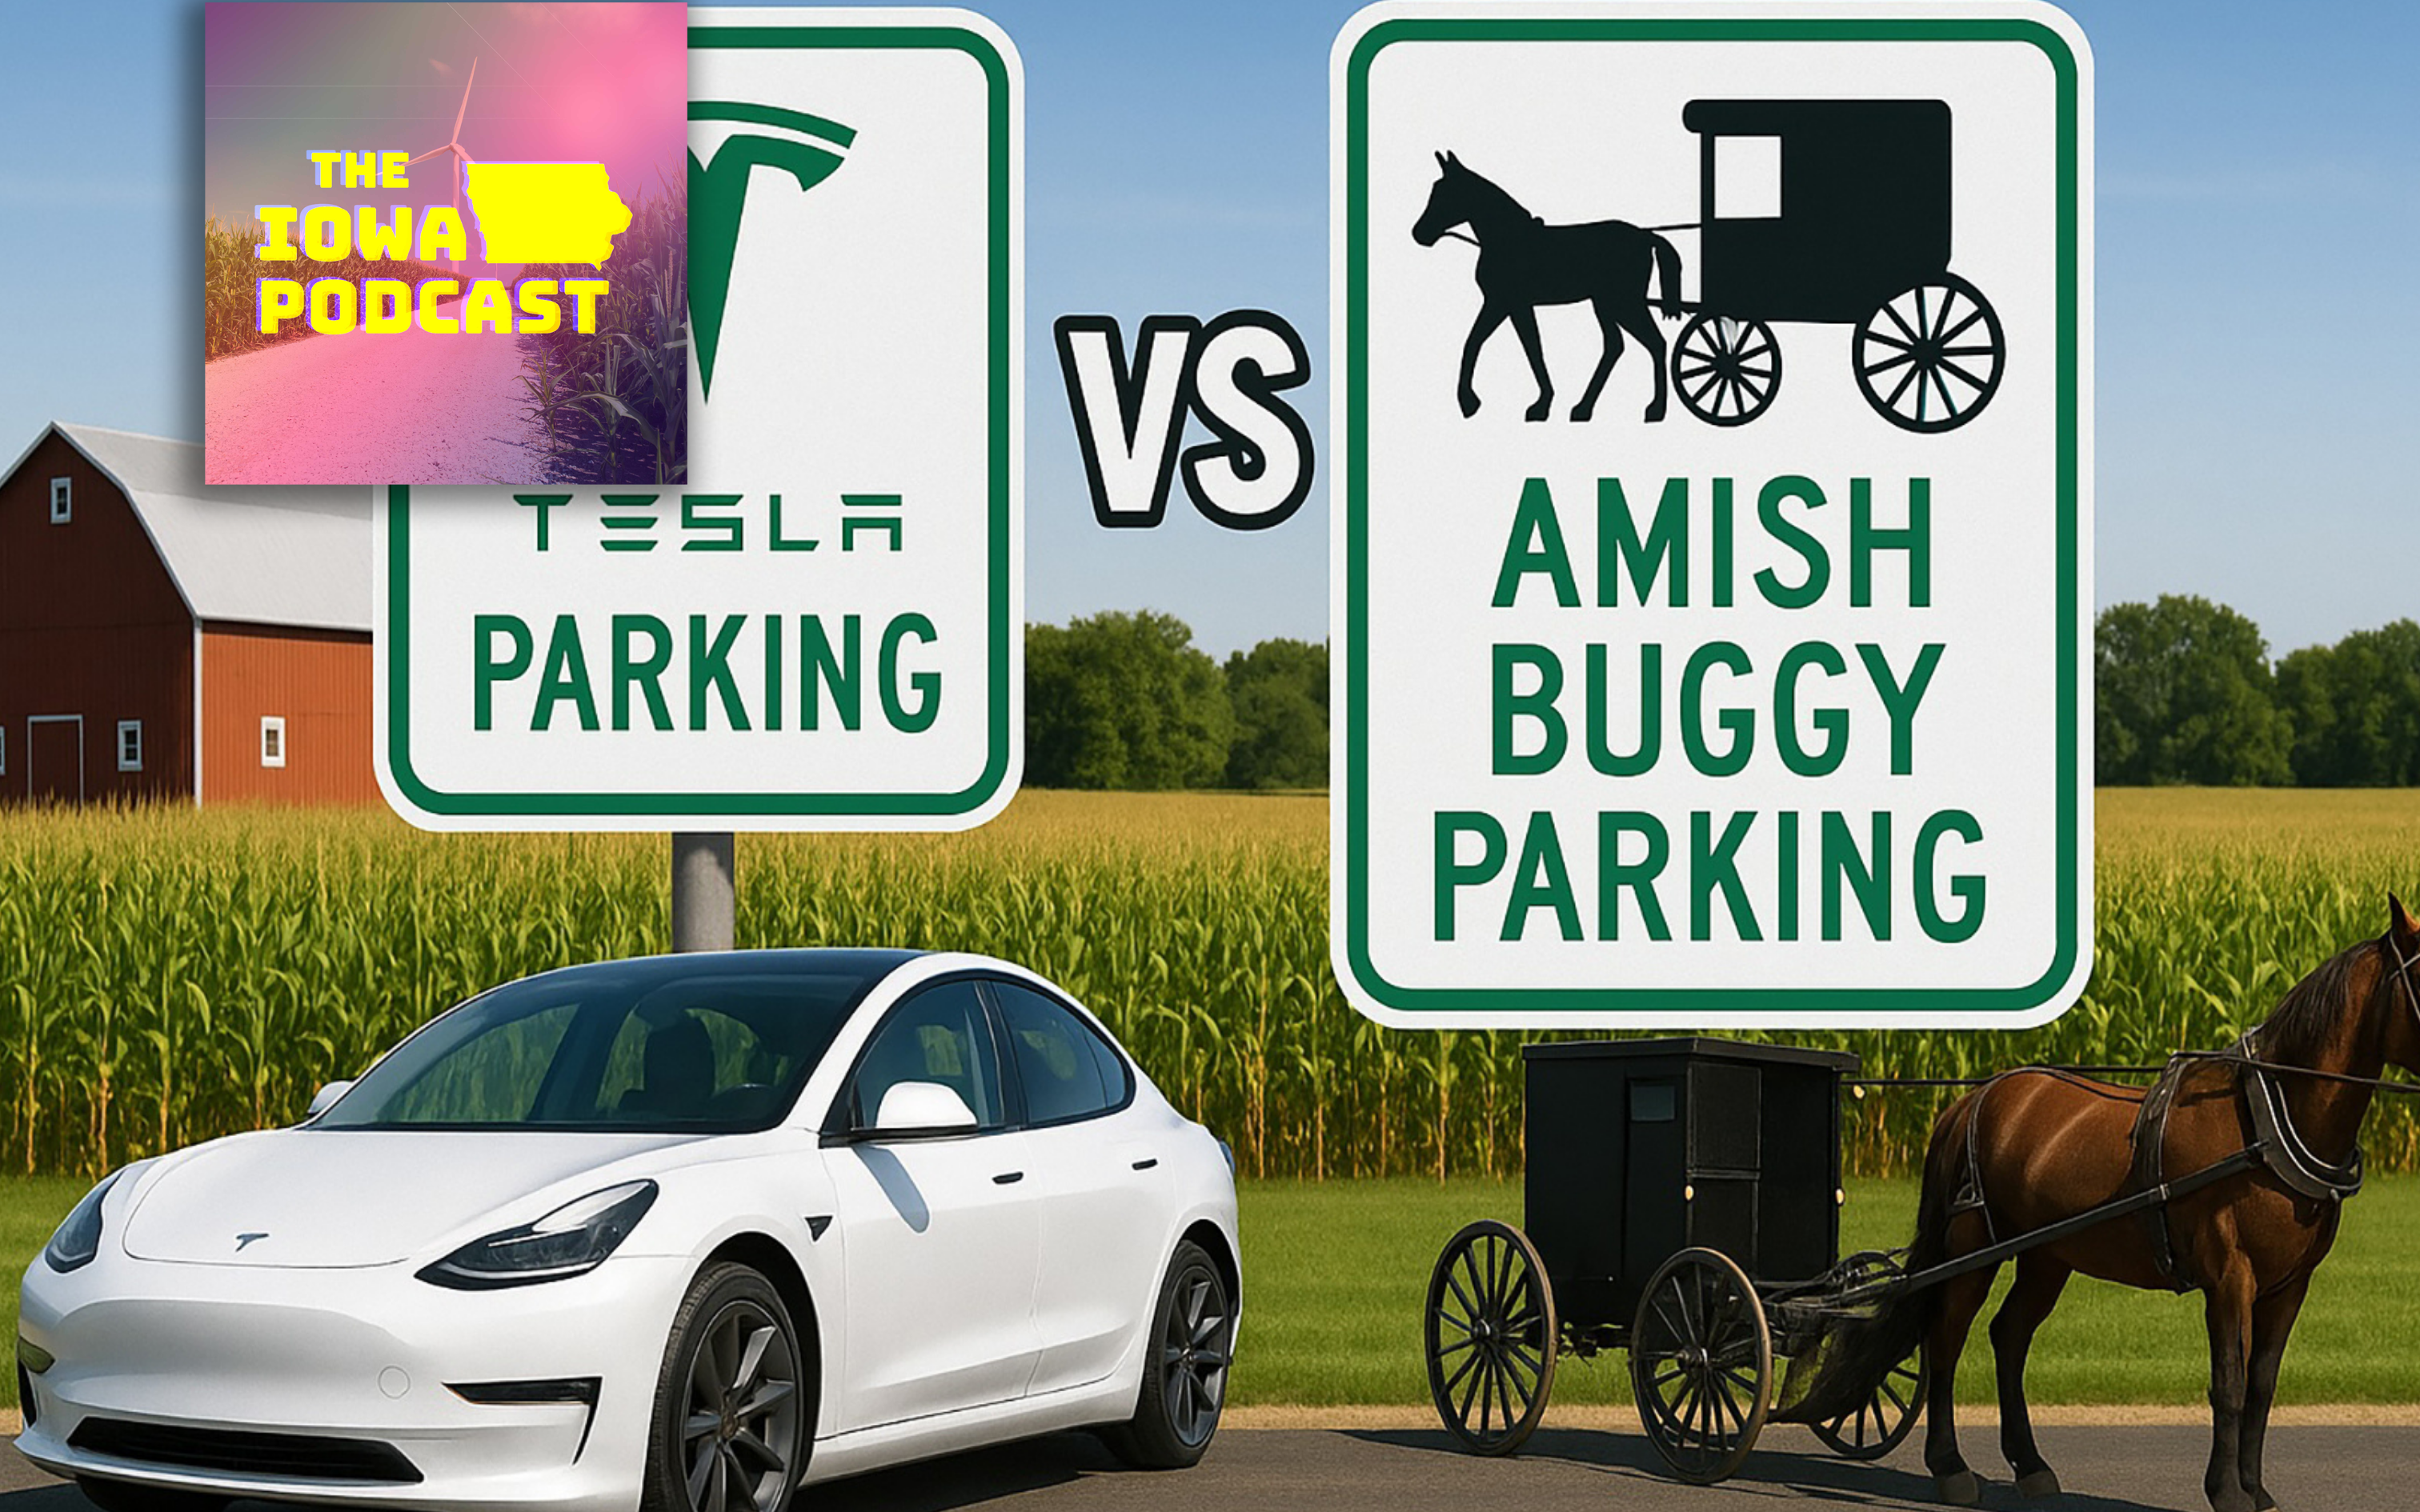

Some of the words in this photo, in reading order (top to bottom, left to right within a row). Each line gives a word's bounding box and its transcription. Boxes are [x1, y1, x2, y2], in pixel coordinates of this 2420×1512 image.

[512, 493, 903, 552] TESLA
[1492, 475, 1931, 609] AMISH
[473, 612, 943, 734] PARKING
[1492, 641, 1945, 777] BUGGY
[1433, 809, 1987, 944] PARKING
